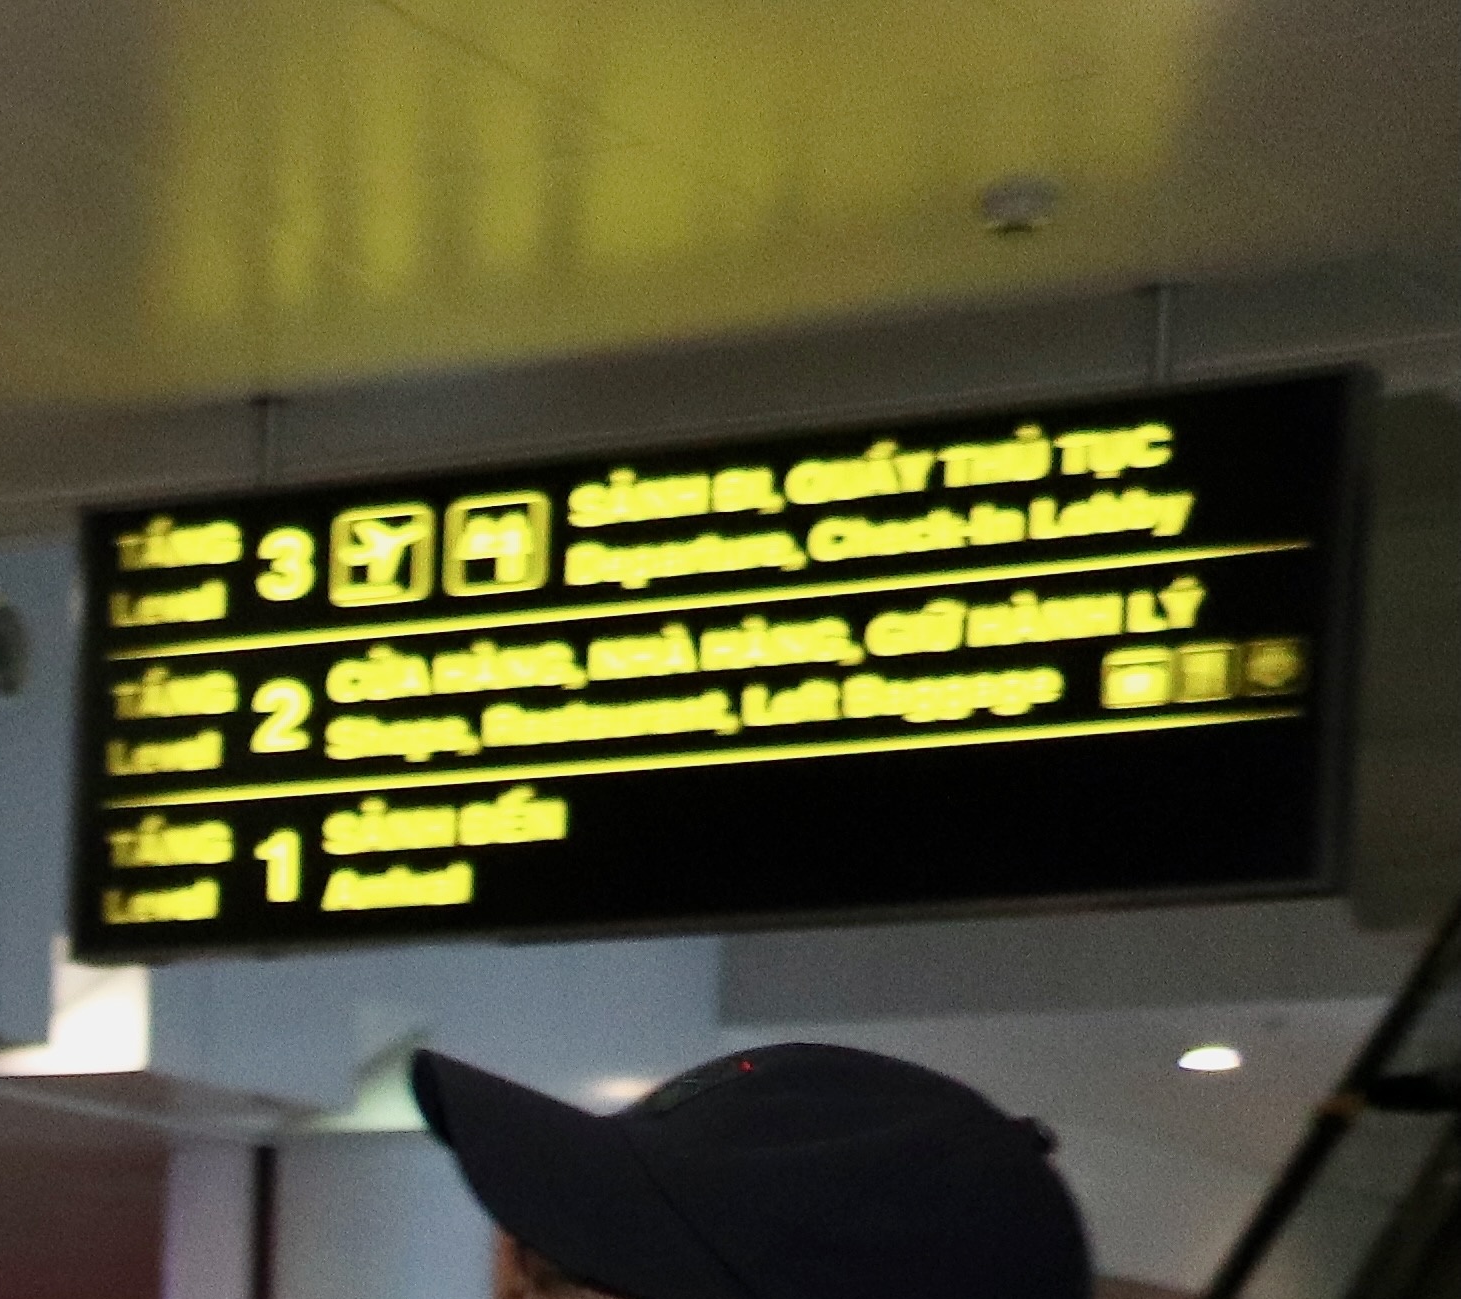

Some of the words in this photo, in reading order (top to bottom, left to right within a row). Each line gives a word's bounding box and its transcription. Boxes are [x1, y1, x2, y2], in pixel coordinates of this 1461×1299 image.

[255, 525, 316, 602] 3
[250, 677, 312, 754] 2
[254, 829, 302, 903] 1
